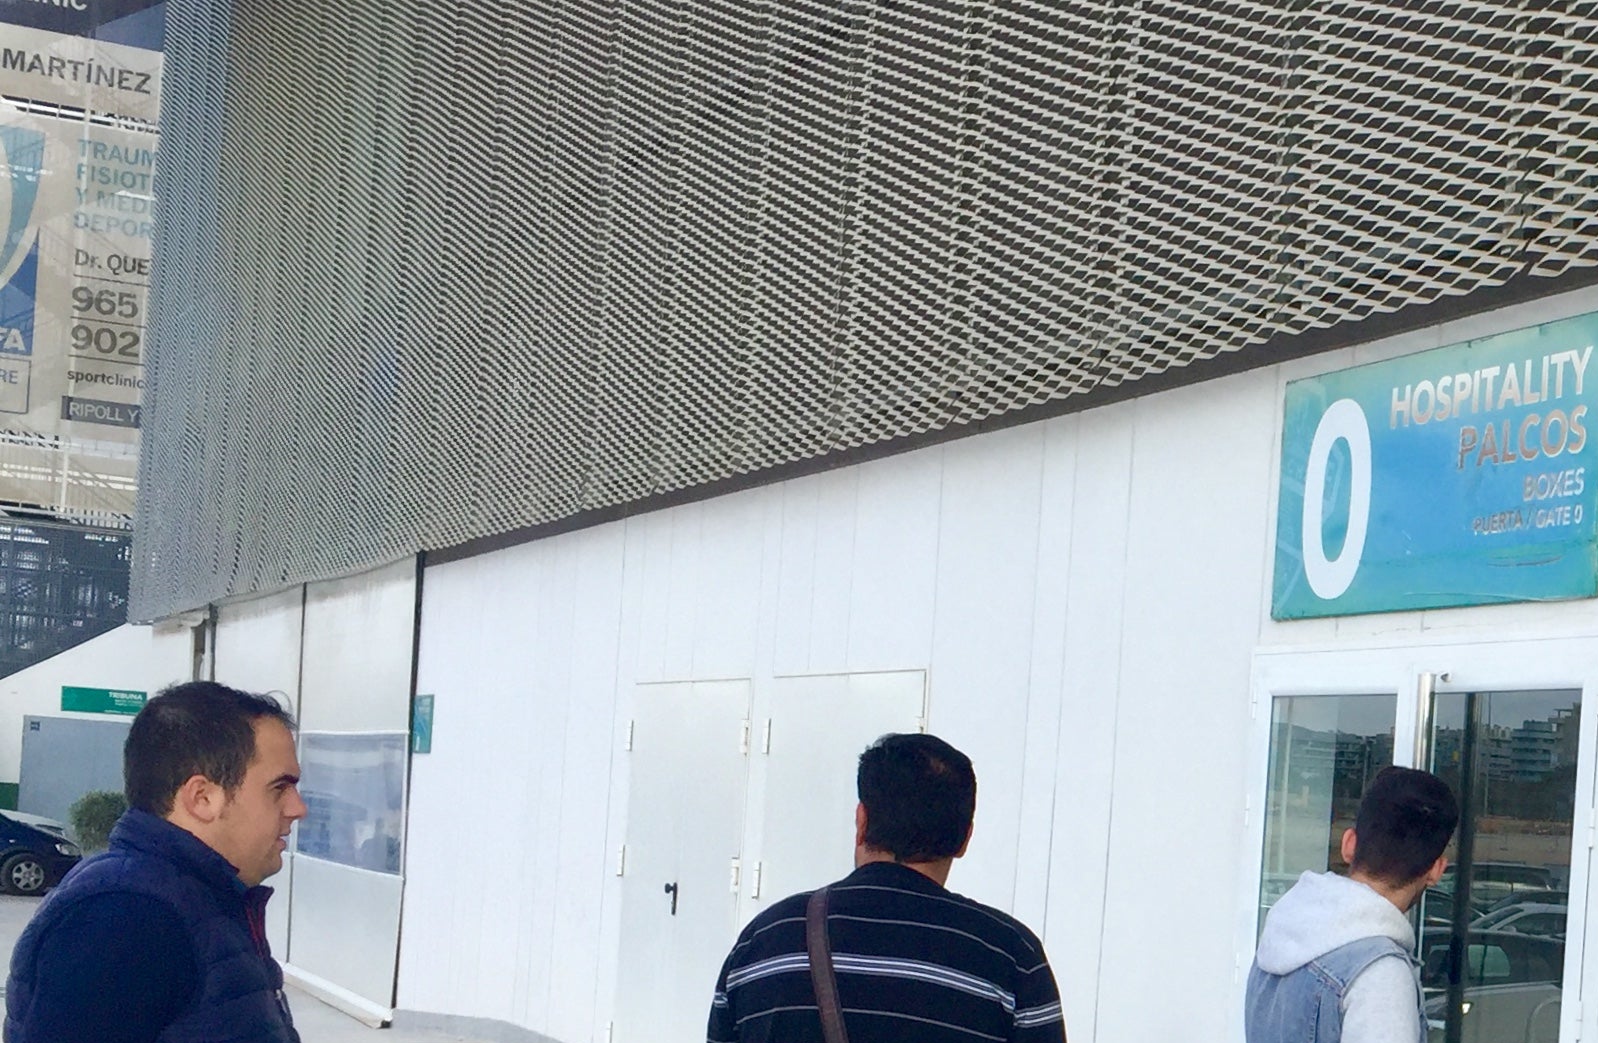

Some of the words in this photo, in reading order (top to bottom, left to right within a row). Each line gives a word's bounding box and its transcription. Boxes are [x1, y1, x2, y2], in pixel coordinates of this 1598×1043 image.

[2, 48, 152, 95] MARTÍNEZ
[74, 249, 102, 269] Dr.
[71, 285, 139, 319] 965
[71, 323, 140, 358] 902
[1390, 346, 1594, 430] HOSPITALITY
[69, 403, 123, 421] RIPOLL
[1456, 405, 1588, 472] PALCOS
[1523, 467, 1586, 503] BOXES
[1473, 508, 1525, 536] PUERTA
[1535, 507, 1571, 529] GATE
[1574, 504, 1584, 526] 0
